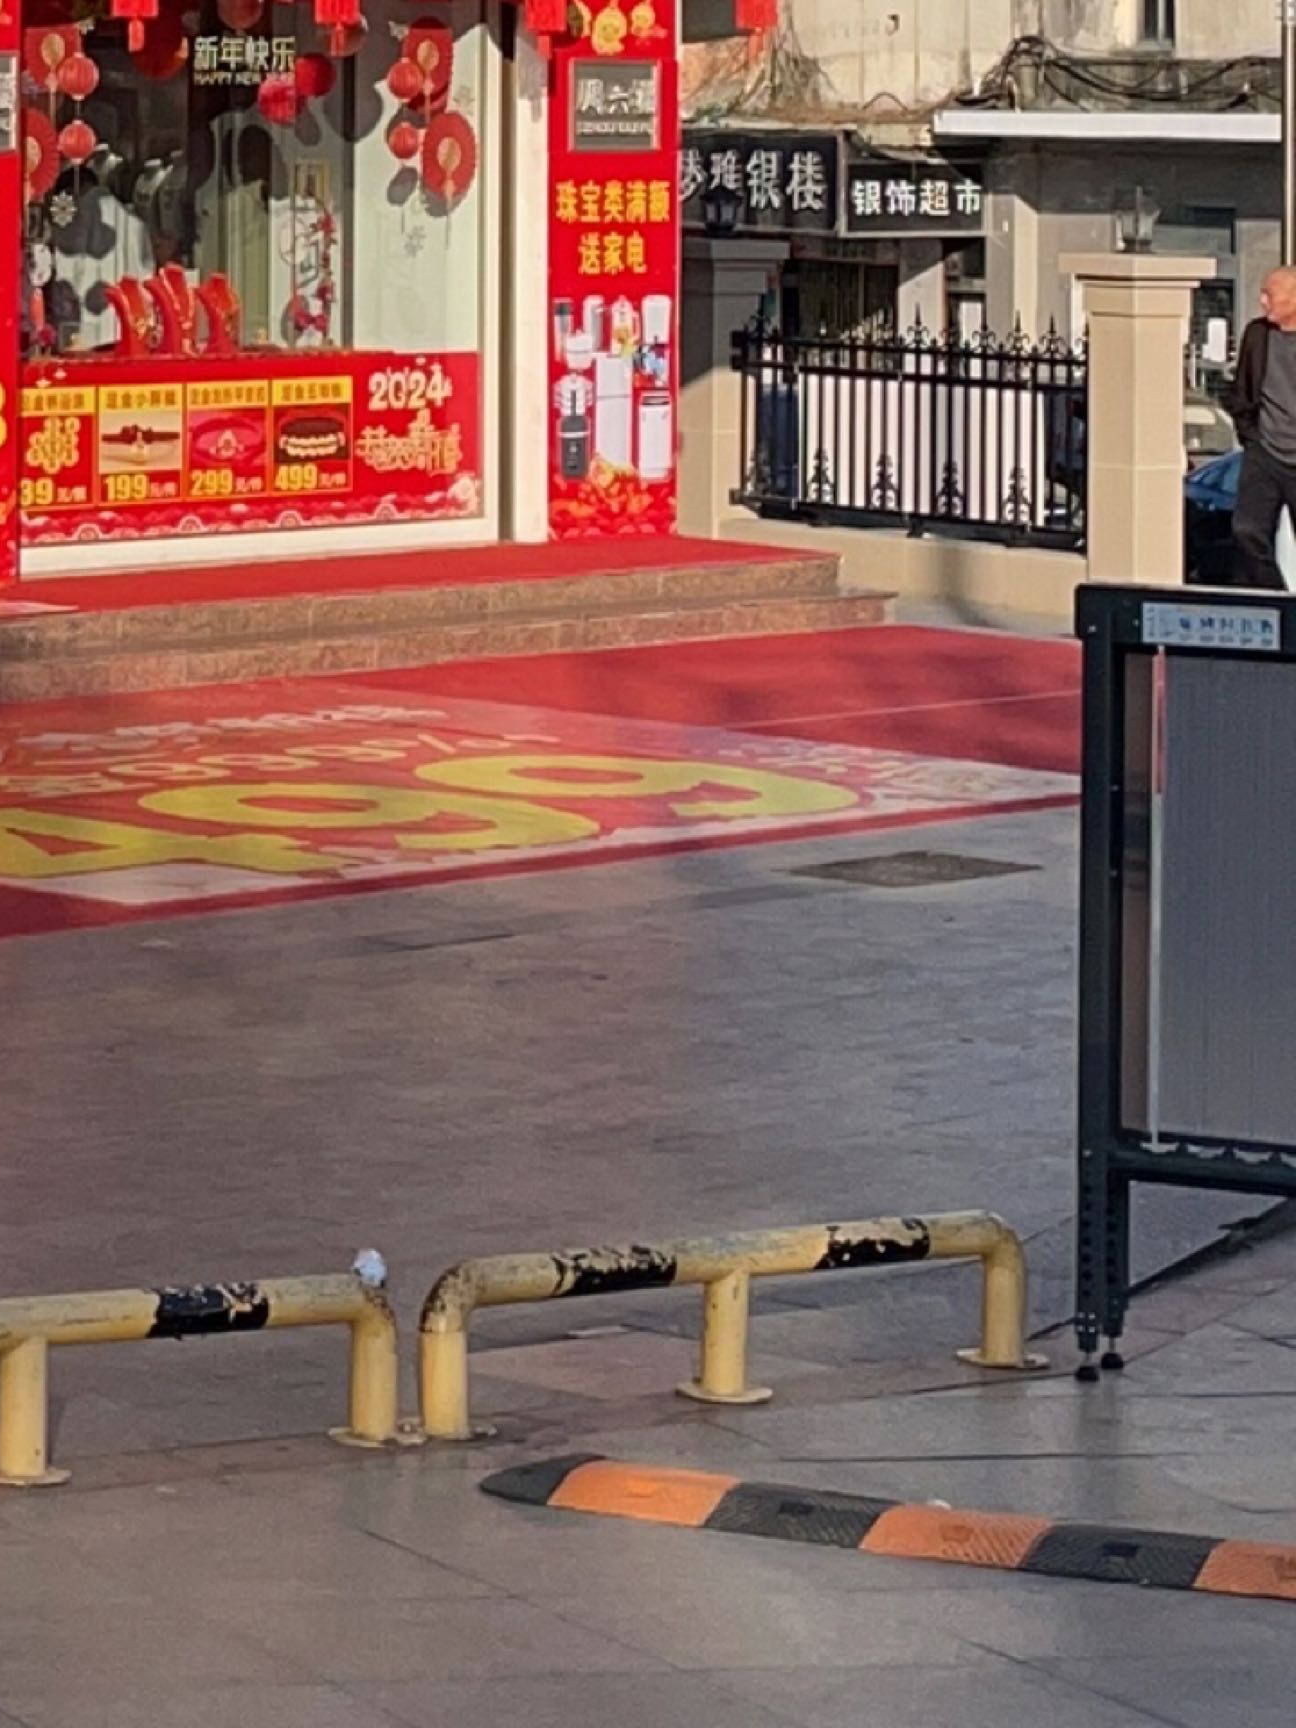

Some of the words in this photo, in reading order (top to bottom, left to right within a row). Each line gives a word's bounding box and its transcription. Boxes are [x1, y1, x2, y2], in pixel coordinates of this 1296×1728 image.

[194, 35, 296, 72] 新年快乐
[853, 179, 982, 217] 银饰超市
[578, 230, 648, 275] 送家电
[368, 364, 452, 410] 2024
